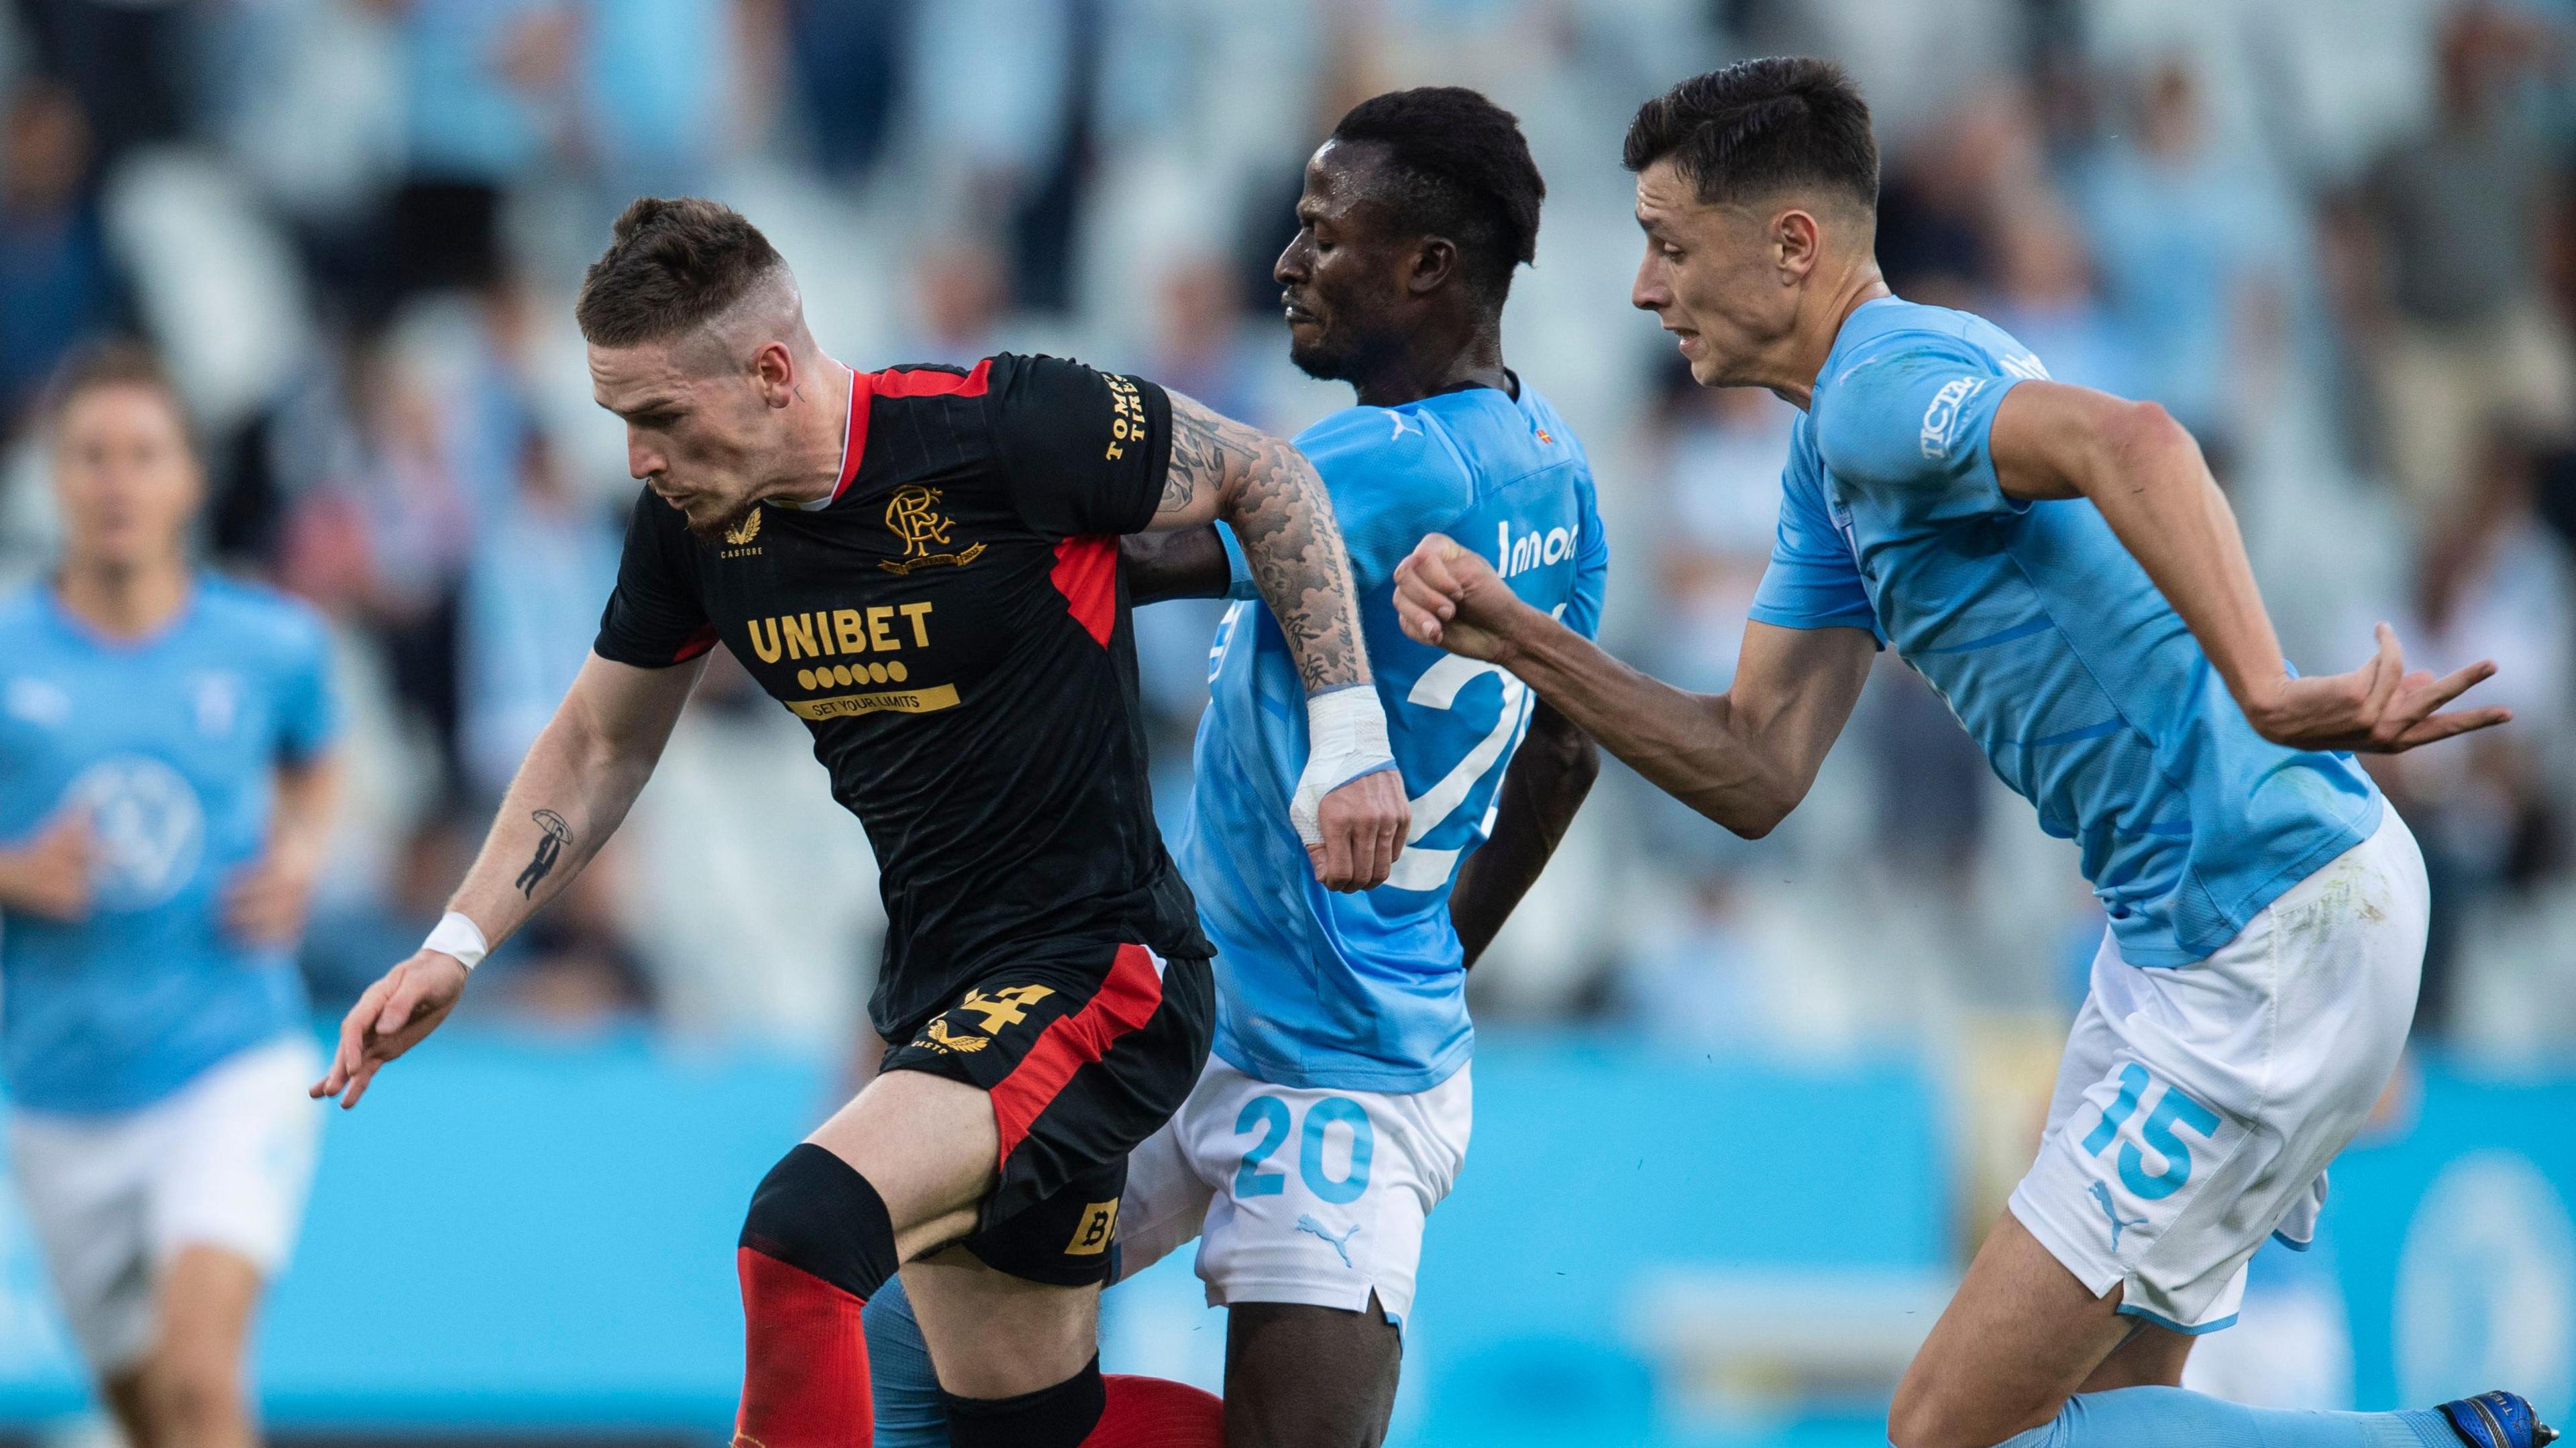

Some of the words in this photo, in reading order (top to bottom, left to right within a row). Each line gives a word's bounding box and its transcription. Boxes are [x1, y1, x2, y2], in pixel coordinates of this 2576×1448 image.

[720, 547, 763, 559] CASTORE
[747, 602, 932, 663] UNIBET
[812, 703, 837, 716] SET
[838, 698, 876, 712] YOUR
[877, 695, 920, 708] LIMITS
[1234, 1095, 1374, 1205] 20
[2081, 1062, 2221, 1201] 15
